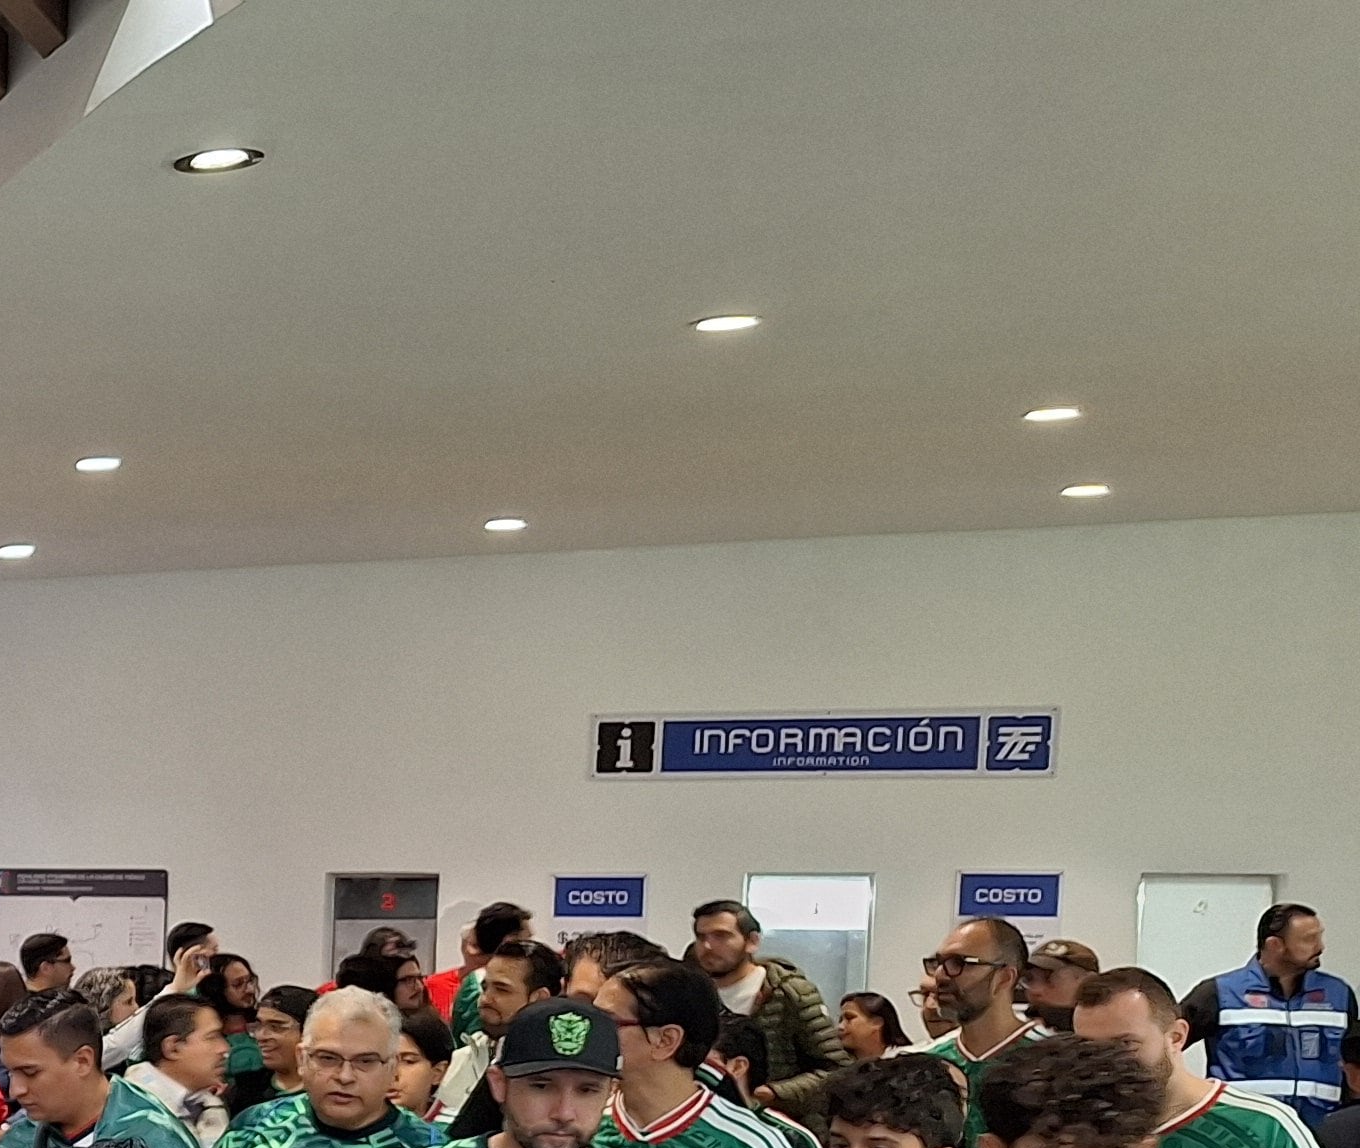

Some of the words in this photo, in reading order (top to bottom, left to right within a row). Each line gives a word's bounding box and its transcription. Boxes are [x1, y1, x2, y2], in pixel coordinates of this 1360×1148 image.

[693, 718, 964, 754] INFORMACIÓN
[771, 756, 871, 767] INFORMATION
[567, 889, 629, 906] COSTO
[974, 888, 1042, 904] COSTO
